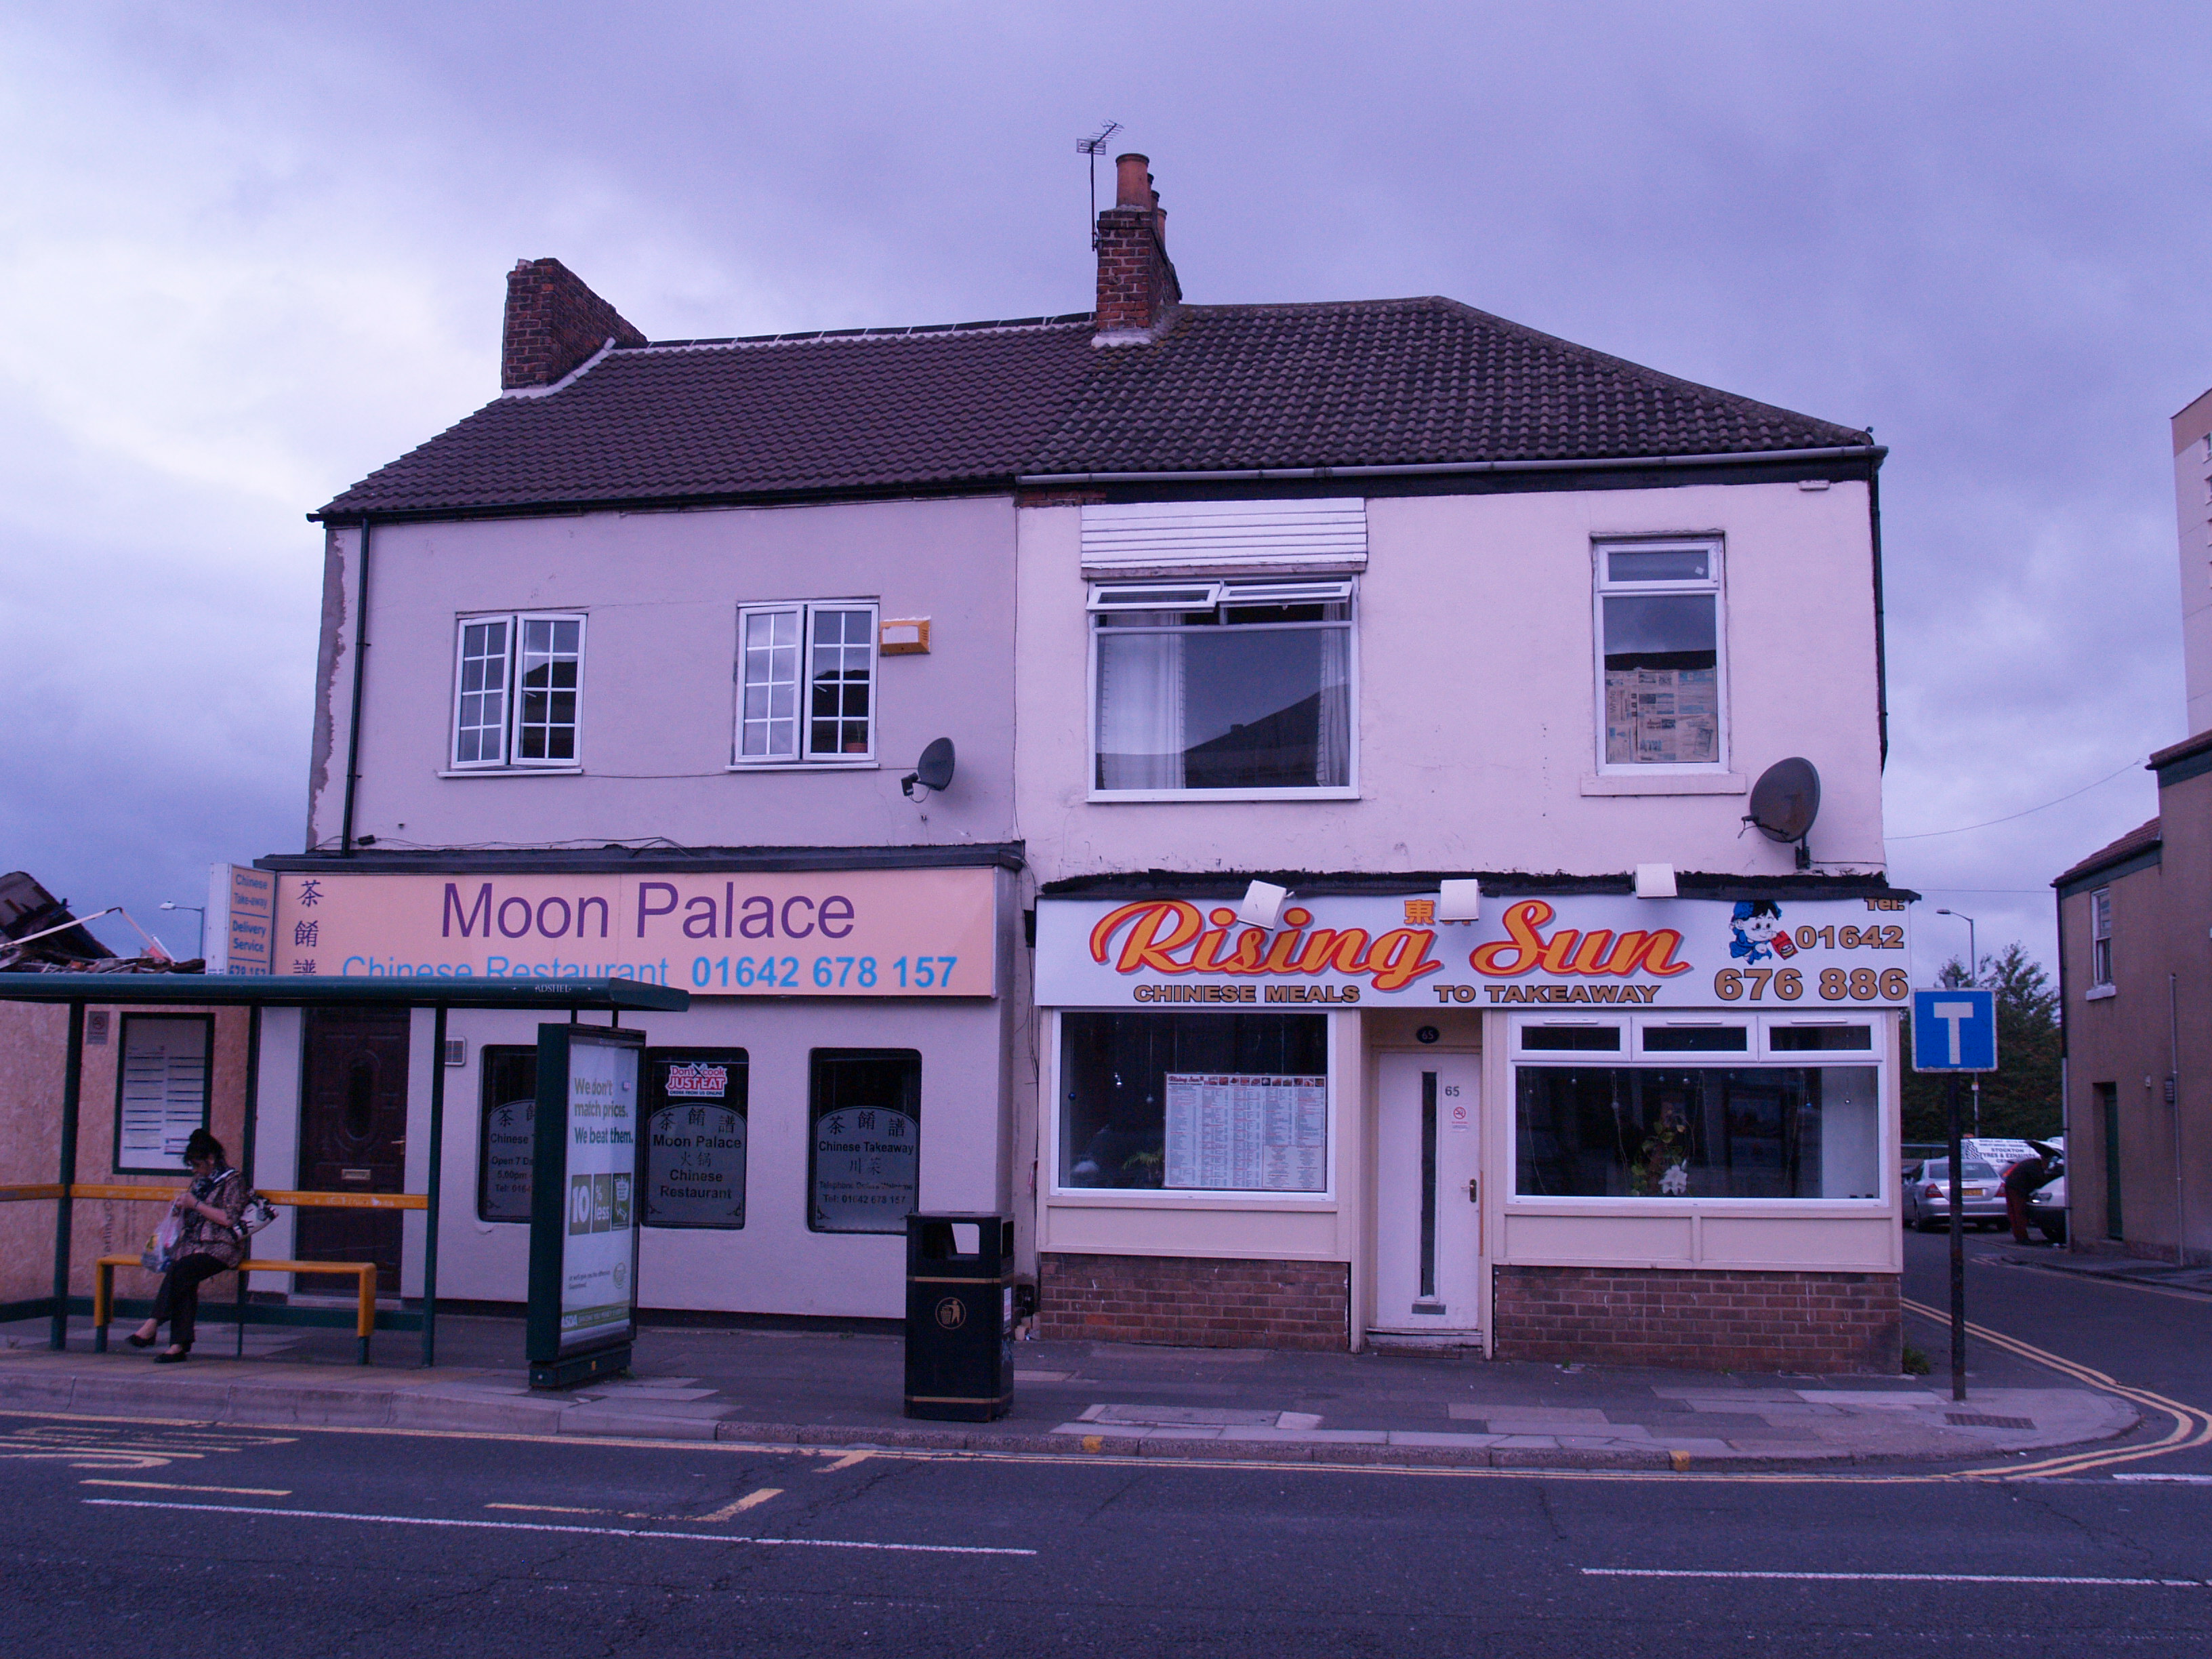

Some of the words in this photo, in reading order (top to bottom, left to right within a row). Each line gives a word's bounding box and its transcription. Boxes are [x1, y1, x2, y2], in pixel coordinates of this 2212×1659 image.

[236, 874, 268, 889] Chinese
[442, 882, 609, 939] Moon
[636, 882, 855, 939] Palace
[1864, 898, 1905, 911] Tel:
[232, 920, 266, 938] Delivery
[1795, 925, 1904, 949] 01642
[233, 938, 264, 952] Service
[1089, 899, 1441, 991] Rising
[1469, 899, 1691, 977] Sun
[692, 956, 800, 987] 01642
[813, 956, 878, 987] 678
[893, 956, 958, 987] 157
[1715, 968, 1803, 1000] 676
[1818, 968, 1908, 1000] 886
[1134, 985, 1257, 1003] CHINESE
[1264, 985, 1360, 1003] MEALS
[1433, 985, 1476, 1003] TO
[1484, 985, 1661, 1003] TAKEAWAY
[1422, 1030, 1433, 1040] 65
[703, 1067, 725, 1076] cook
[574, 1078, 590, 1094] We
[592, 1078, 613, 1095] don't
[668, 1077, 699, 1089] JUST
[700, 1078, 726, 1090] EAT
[1445, 1086, 1460, 1097] 65
[574, 1099, 601, 1117] match
[602, 1100, 628, 1120] prices.
[490, 1133, 529, 1144] Chinese
[574, 1126, 588, 1144] We
[590, 1126, 608, 1144] beat
[610, 1126, 634, 1144] them.
[653, 1134, 691, 1147] Moon
[696, 1136, 741, 1149] Palace
[819, 1141, 861, 1152] Chinese
[863, 1141, 914, 1155] Takeaway
[492, 1156, 513, 1166] Open
[516, 1157, 520, 1165] 7
[670, 1169, 723, 1182] Chinese
[661, 1186, 731, 1199] Restaurant
[823, 1194, 838, 1203] Tel:
[573, 1185, 590, 1223] 10
[594, 1202, 610, 1221] less
